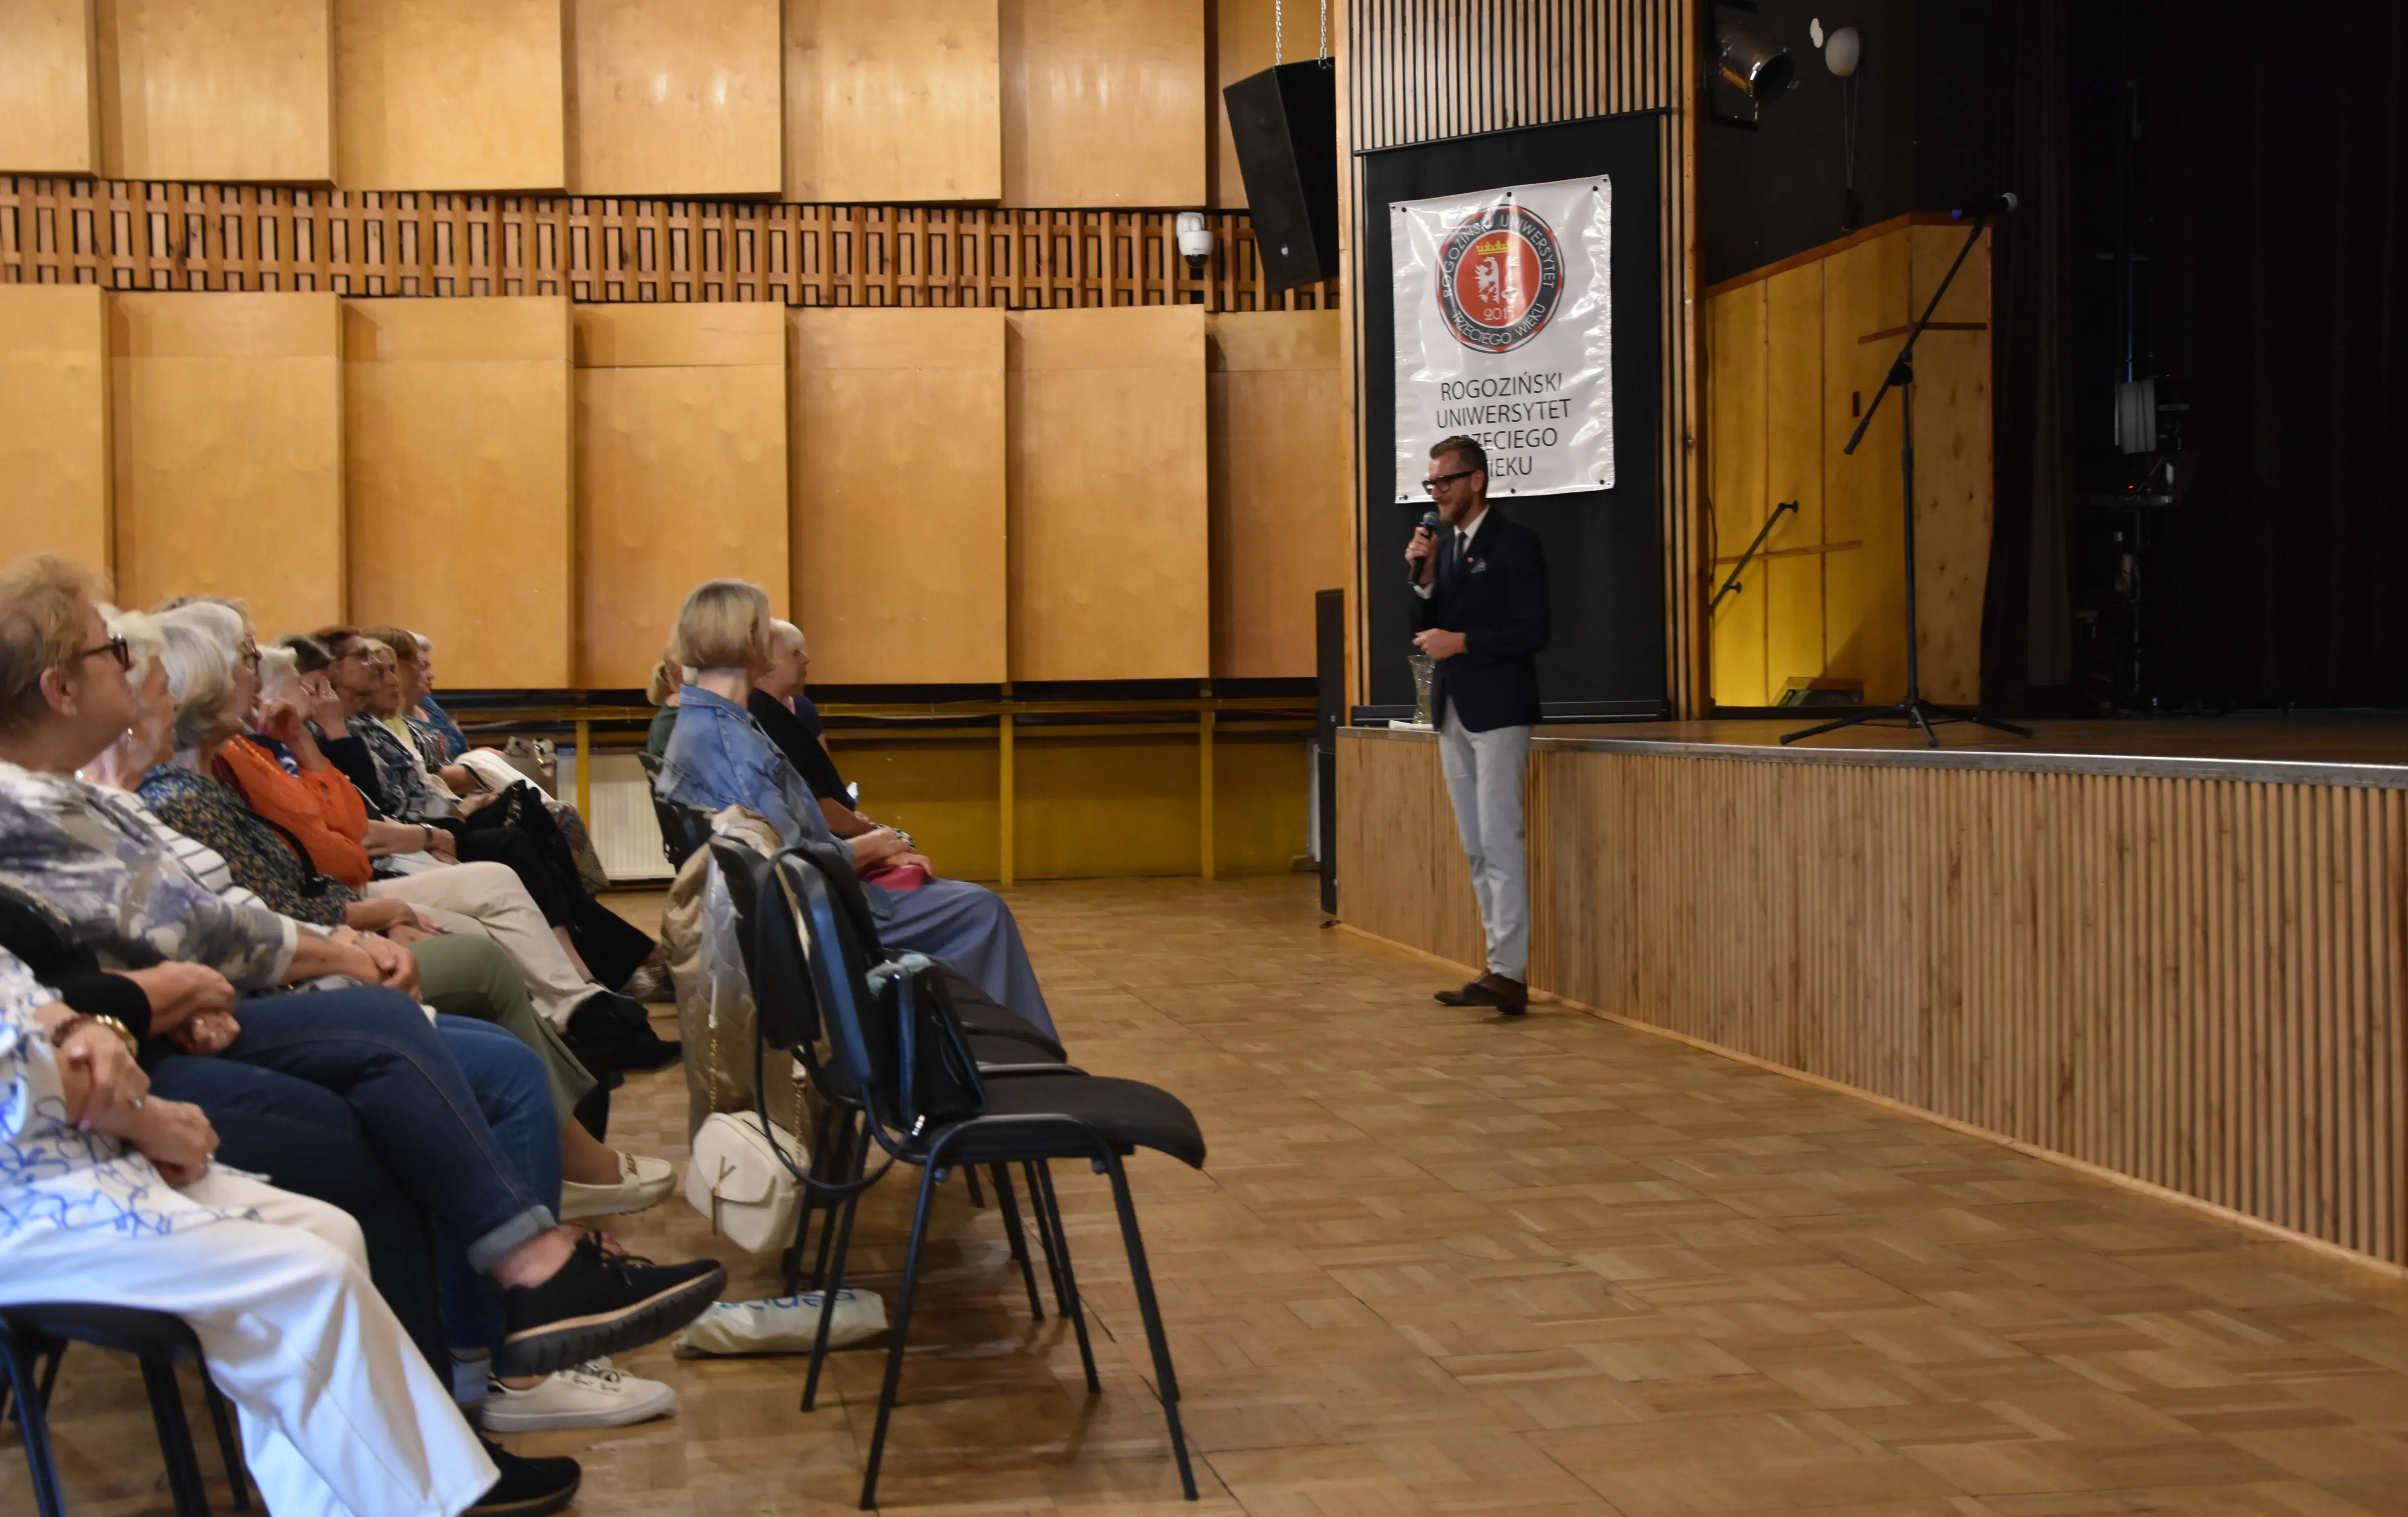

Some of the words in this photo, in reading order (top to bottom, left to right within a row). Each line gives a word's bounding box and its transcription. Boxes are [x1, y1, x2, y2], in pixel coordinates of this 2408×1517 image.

[1514, 303, 1546, 337] WIEKU
[1441, 372, 1562, 401] ROGOZIŃSKI
[1436, 399, 1571, 428] UNIWERSYTET
[1450, 428, 1557, 451] ZECIEGO
[1487, 456, 1533, 478] IEKU
